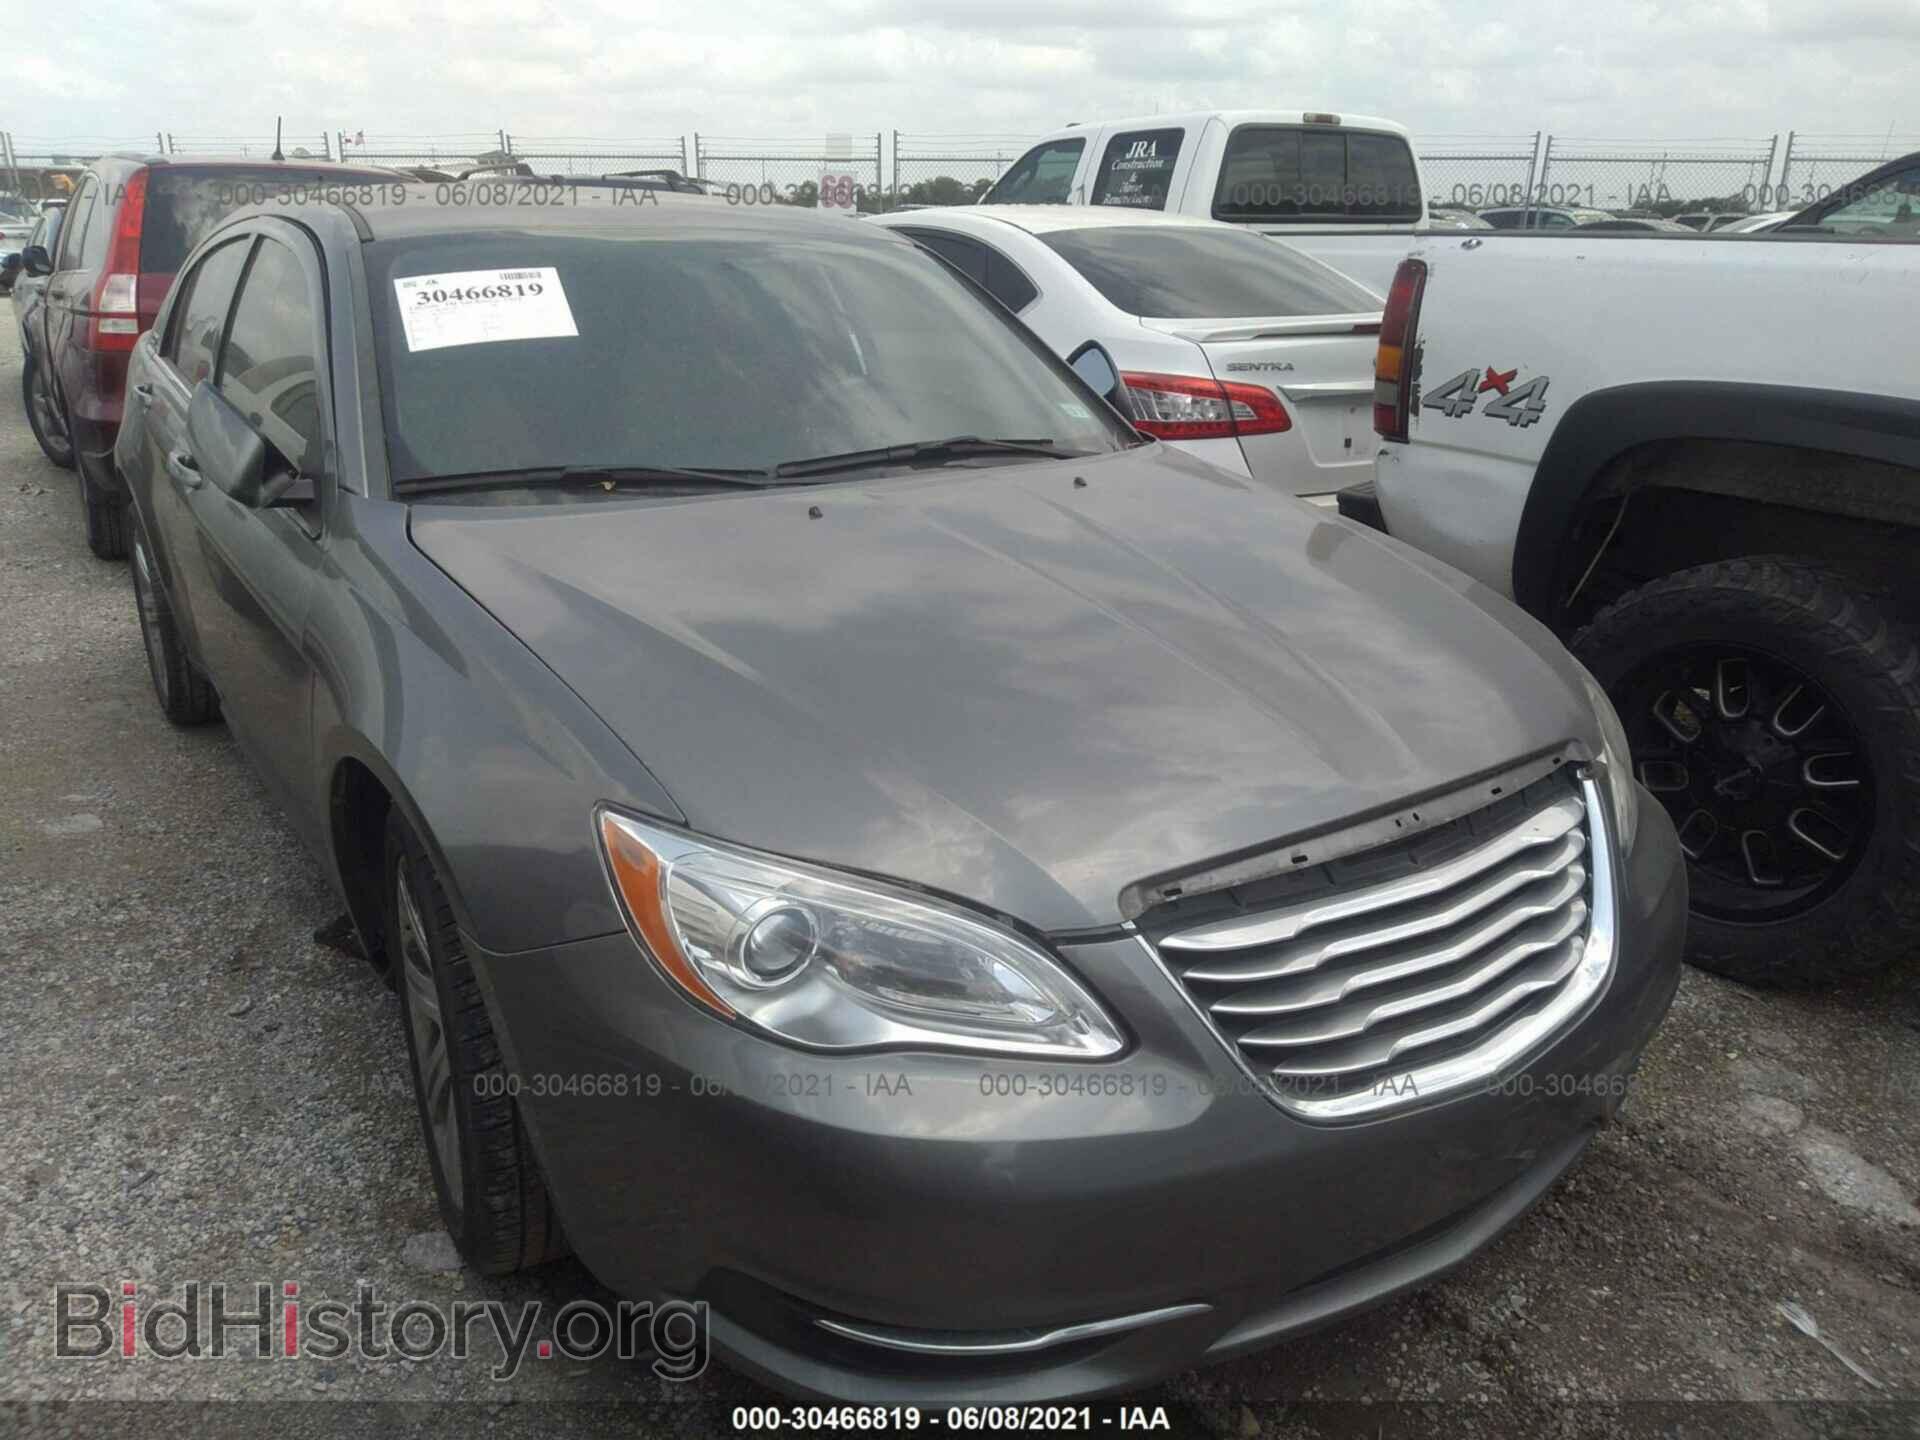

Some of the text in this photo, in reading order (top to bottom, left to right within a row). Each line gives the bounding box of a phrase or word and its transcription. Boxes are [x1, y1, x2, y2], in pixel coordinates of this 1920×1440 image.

[1126, 140, 1157, 159] JRA
[1112, 158, 1164, 171] Construction
[416, 283, 544, 306] 30466819
[1226, 362, 1294, 371] SENTRA
